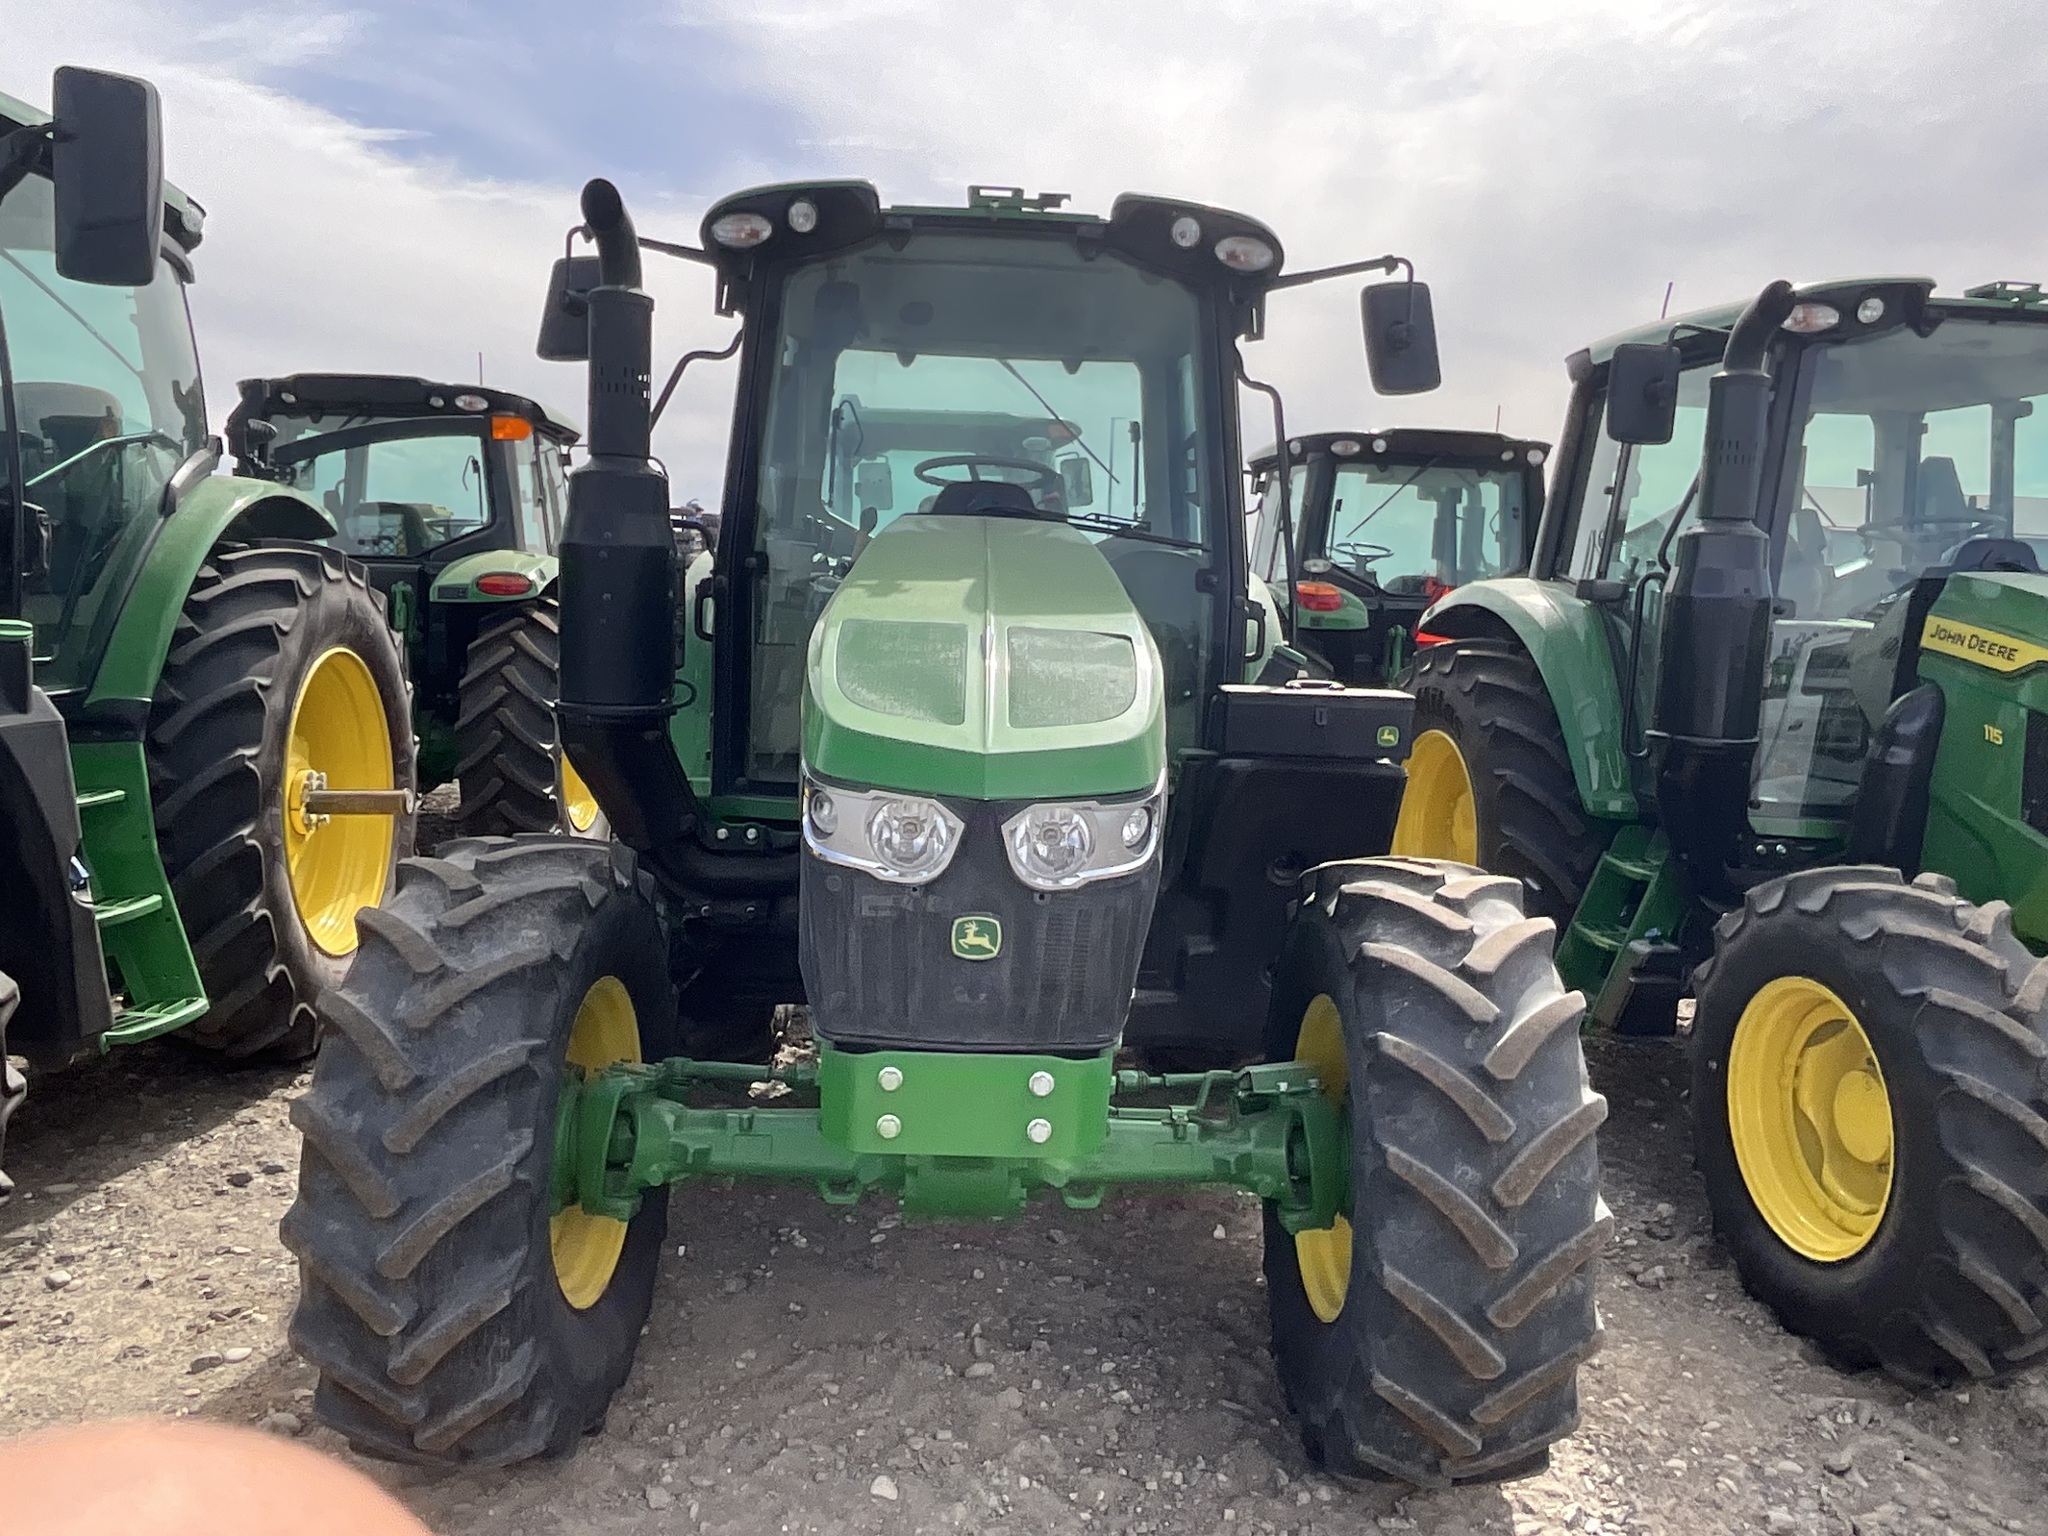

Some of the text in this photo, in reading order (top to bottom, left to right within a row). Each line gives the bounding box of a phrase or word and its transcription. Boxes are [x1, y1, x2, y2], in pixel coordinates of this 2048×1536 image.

[1930, 624, 2018, 662] JOHN DEERE
[1984, 724, 2003, 745] 115
